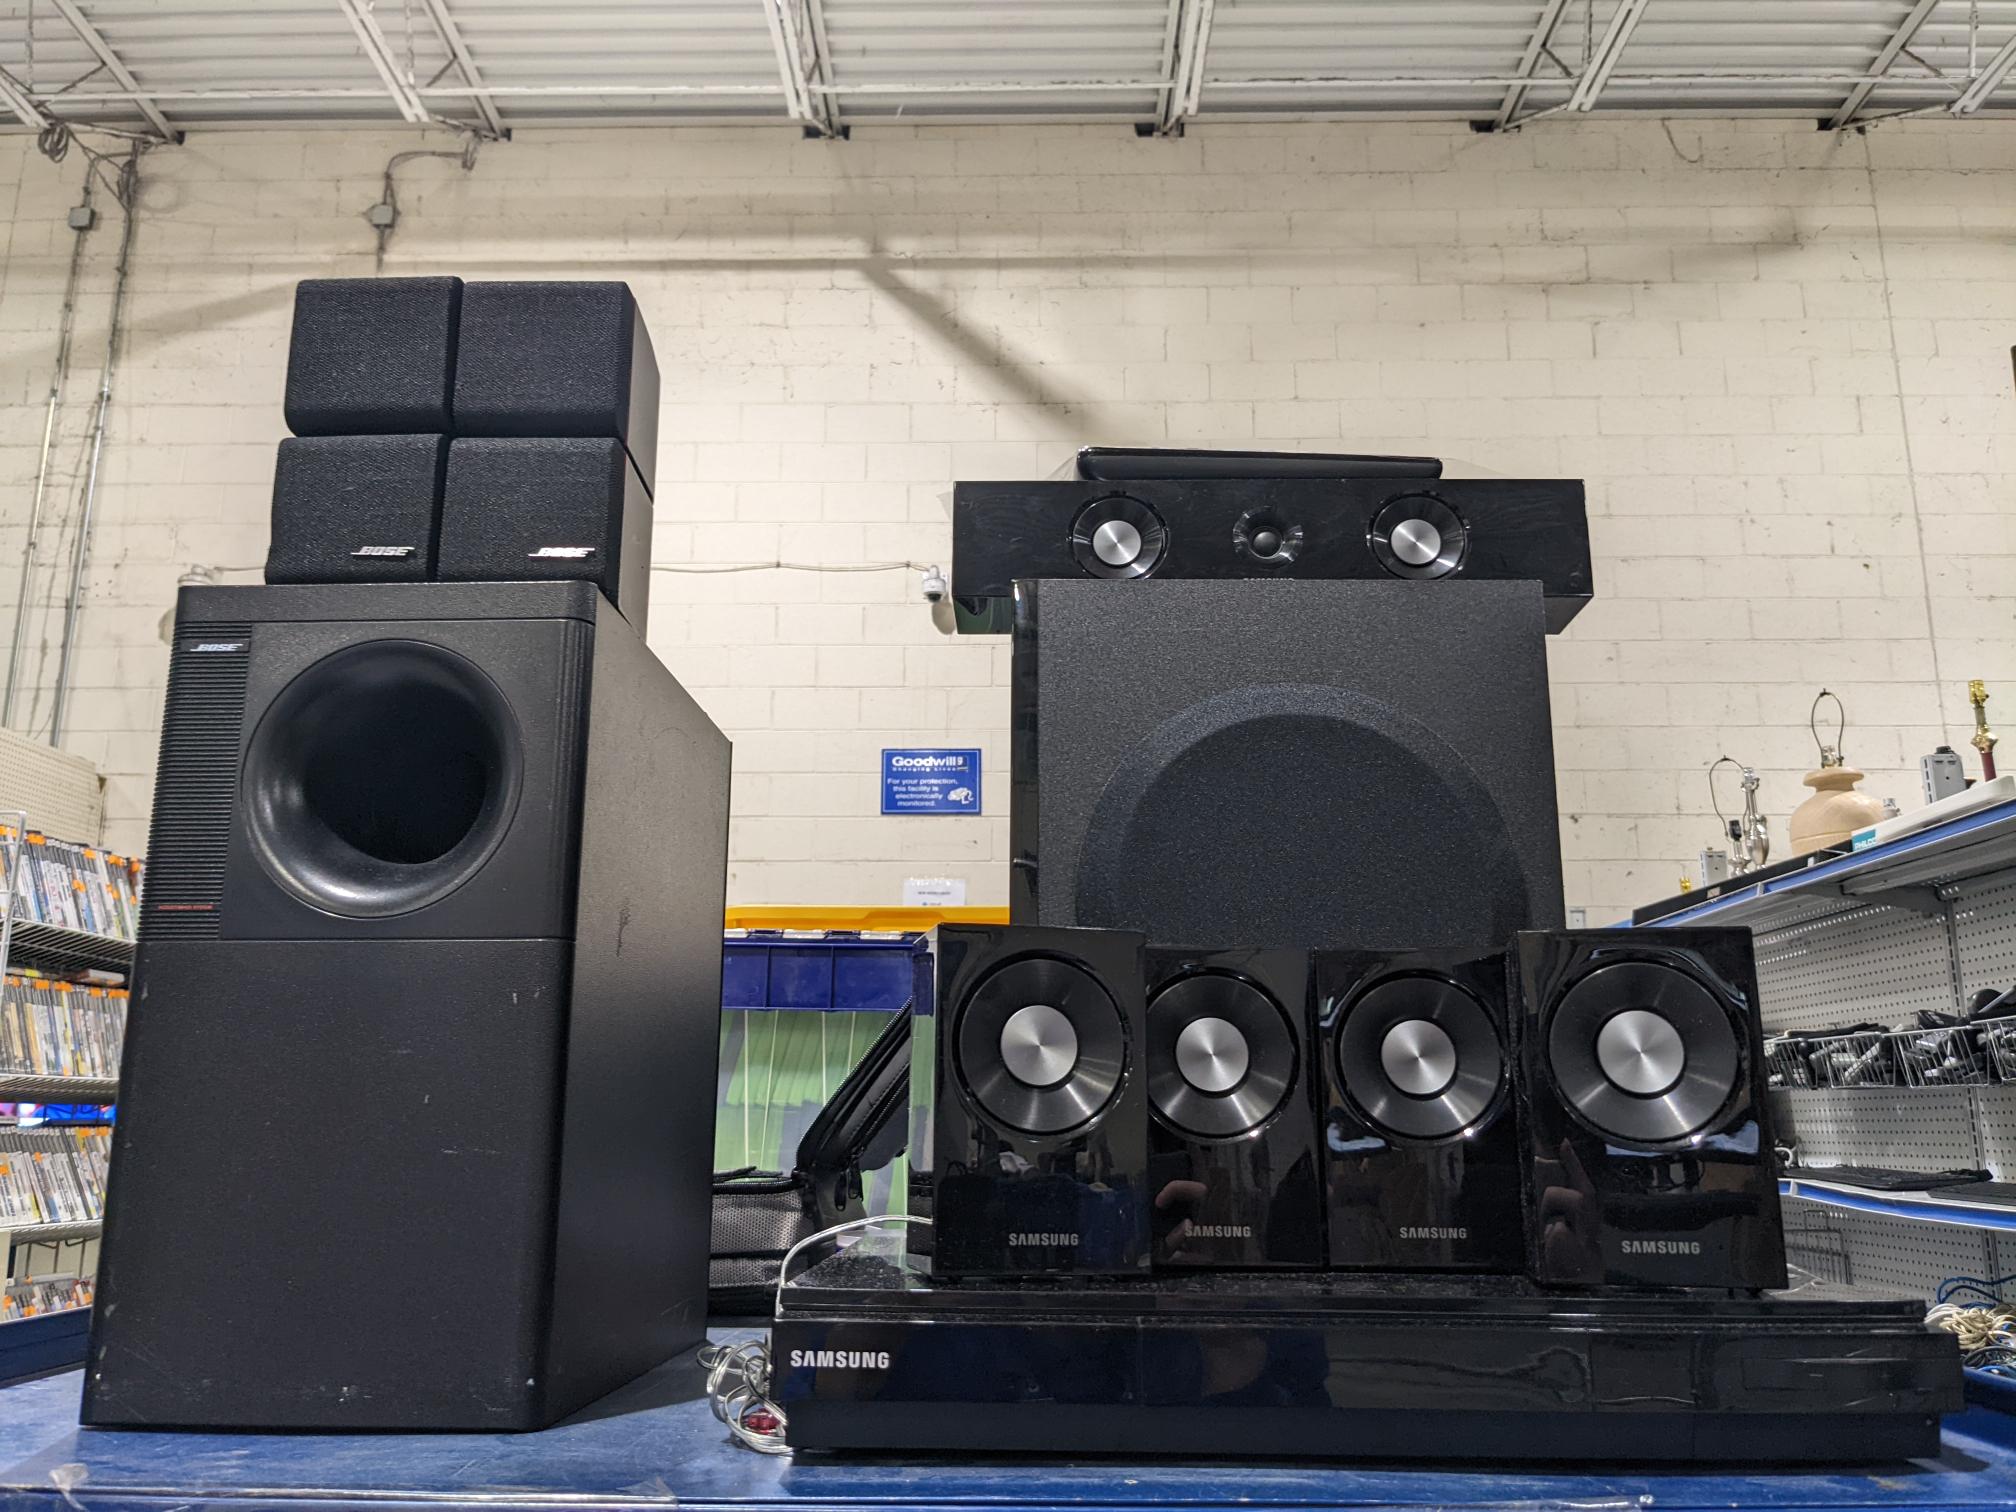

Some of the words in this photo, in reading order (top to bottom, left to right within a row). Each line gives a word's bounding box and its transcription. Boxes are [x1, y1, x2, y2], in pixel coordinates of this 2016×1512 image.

[351, 546, 415, 556] BOSE
[528, 547, 595, 557] BOSE
[190, 643, 243, 651] BOSE
[892, 756, 956, 766] Goodwill
[1184, 1225, 1252, 1238] SAMSUNG
[1400, 1227, 1467, 1239] SAMSUNG
[1008, 1233, 1079, 1246] SAMSUNG
[1621, 1240, 1701, 1254] SAMSUNG
[790, 1349, 890, 1369] SAMSUNG
